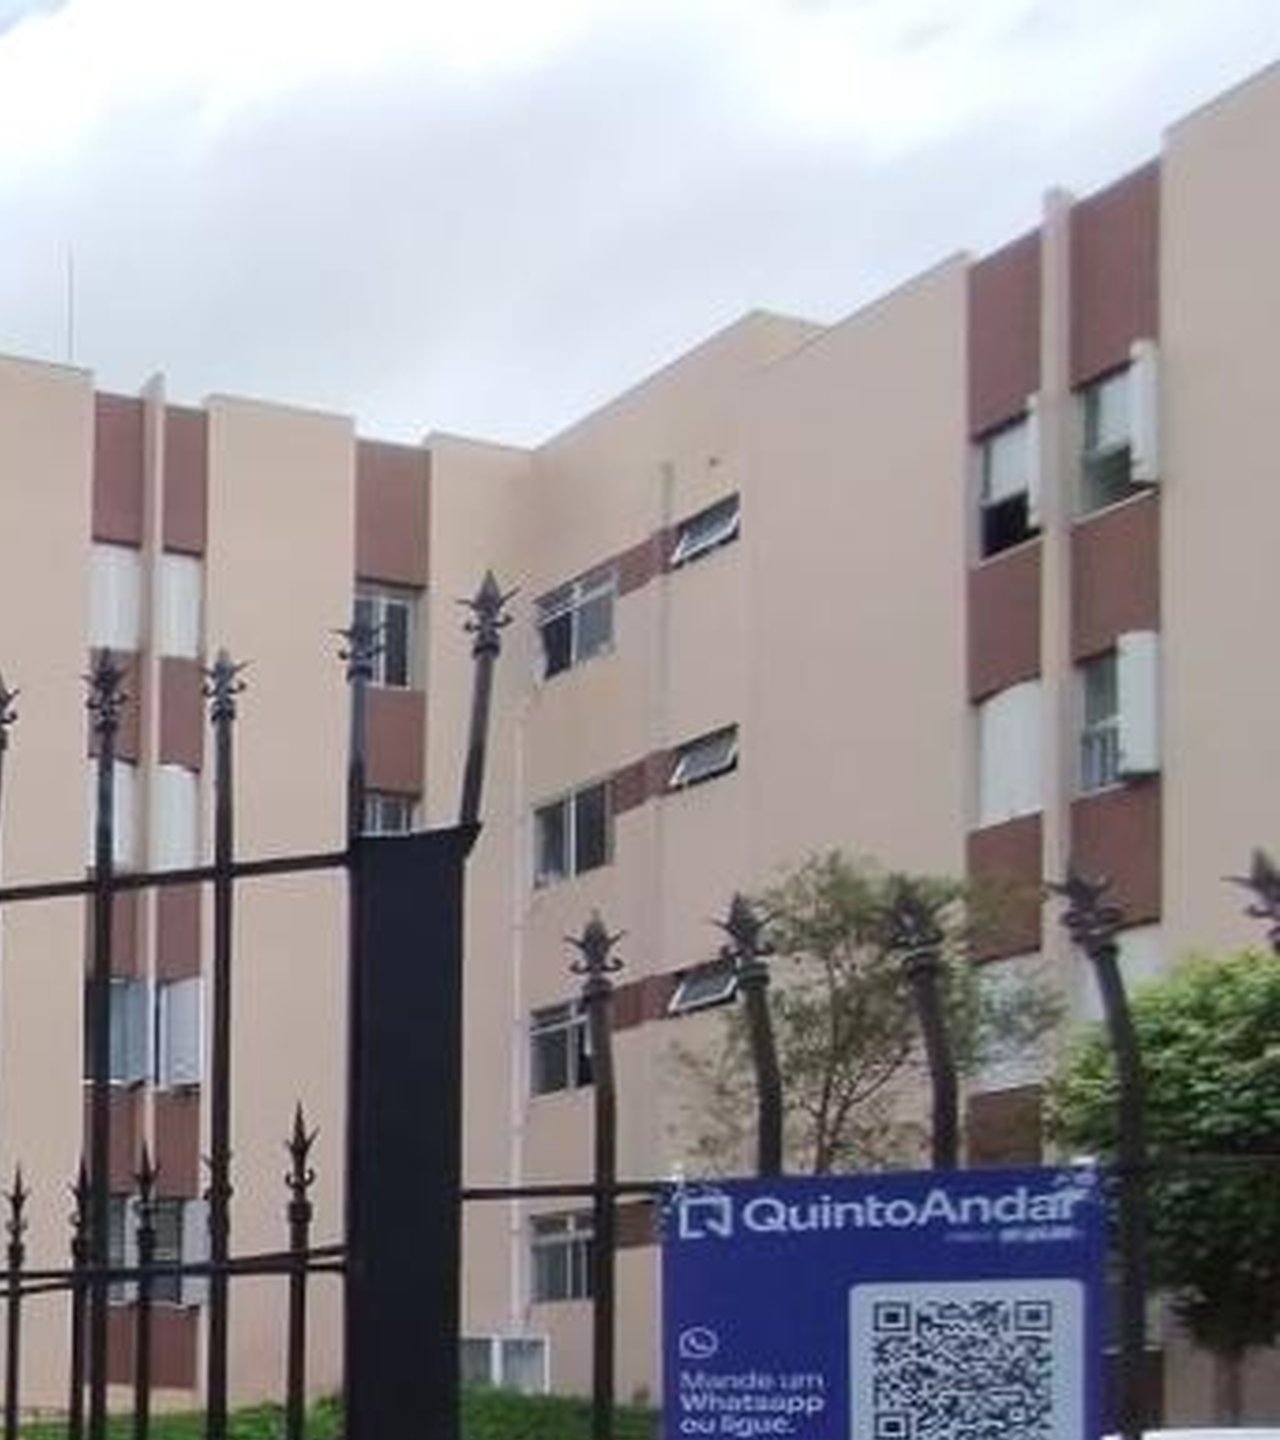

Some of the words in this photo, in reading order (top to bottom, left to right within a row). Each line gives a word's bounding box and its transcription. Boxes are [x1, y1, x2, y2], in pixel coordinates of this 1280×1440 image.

[742, 1187, 1077, 1232] QuintoAndar
[680, 1371, 773, 1390] Mande
[779, 1374, 824, 1390] um
[680, 1417, 717, 1434] ou
